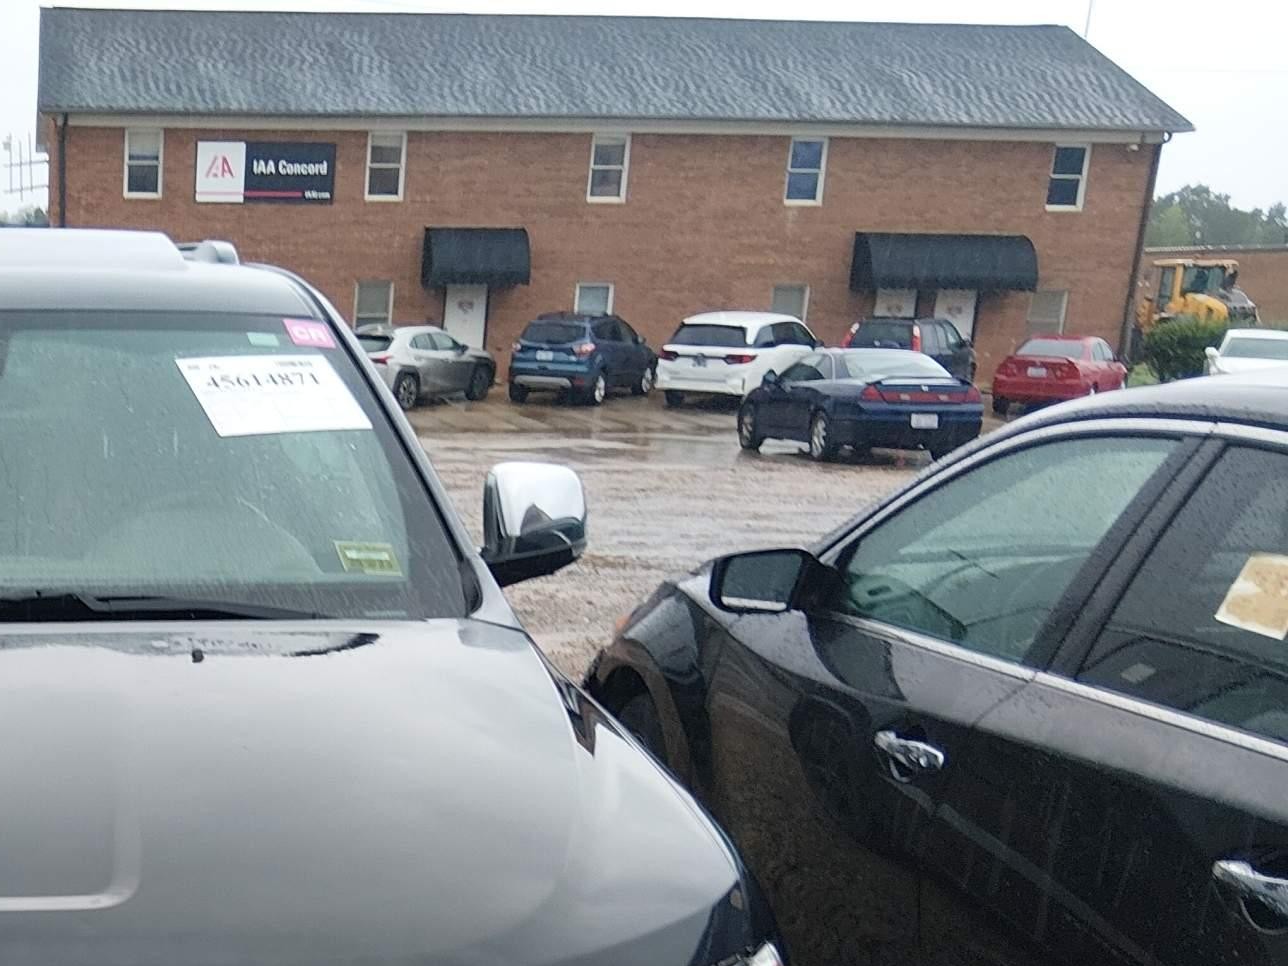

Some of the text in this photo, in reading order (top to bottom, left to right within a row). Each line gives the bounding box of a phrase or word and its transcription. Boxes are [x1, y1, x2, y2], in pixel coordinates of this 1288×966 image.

[253, 159, 328, 176] IAA Concord
[206, 372, 320, 389] 45614871
